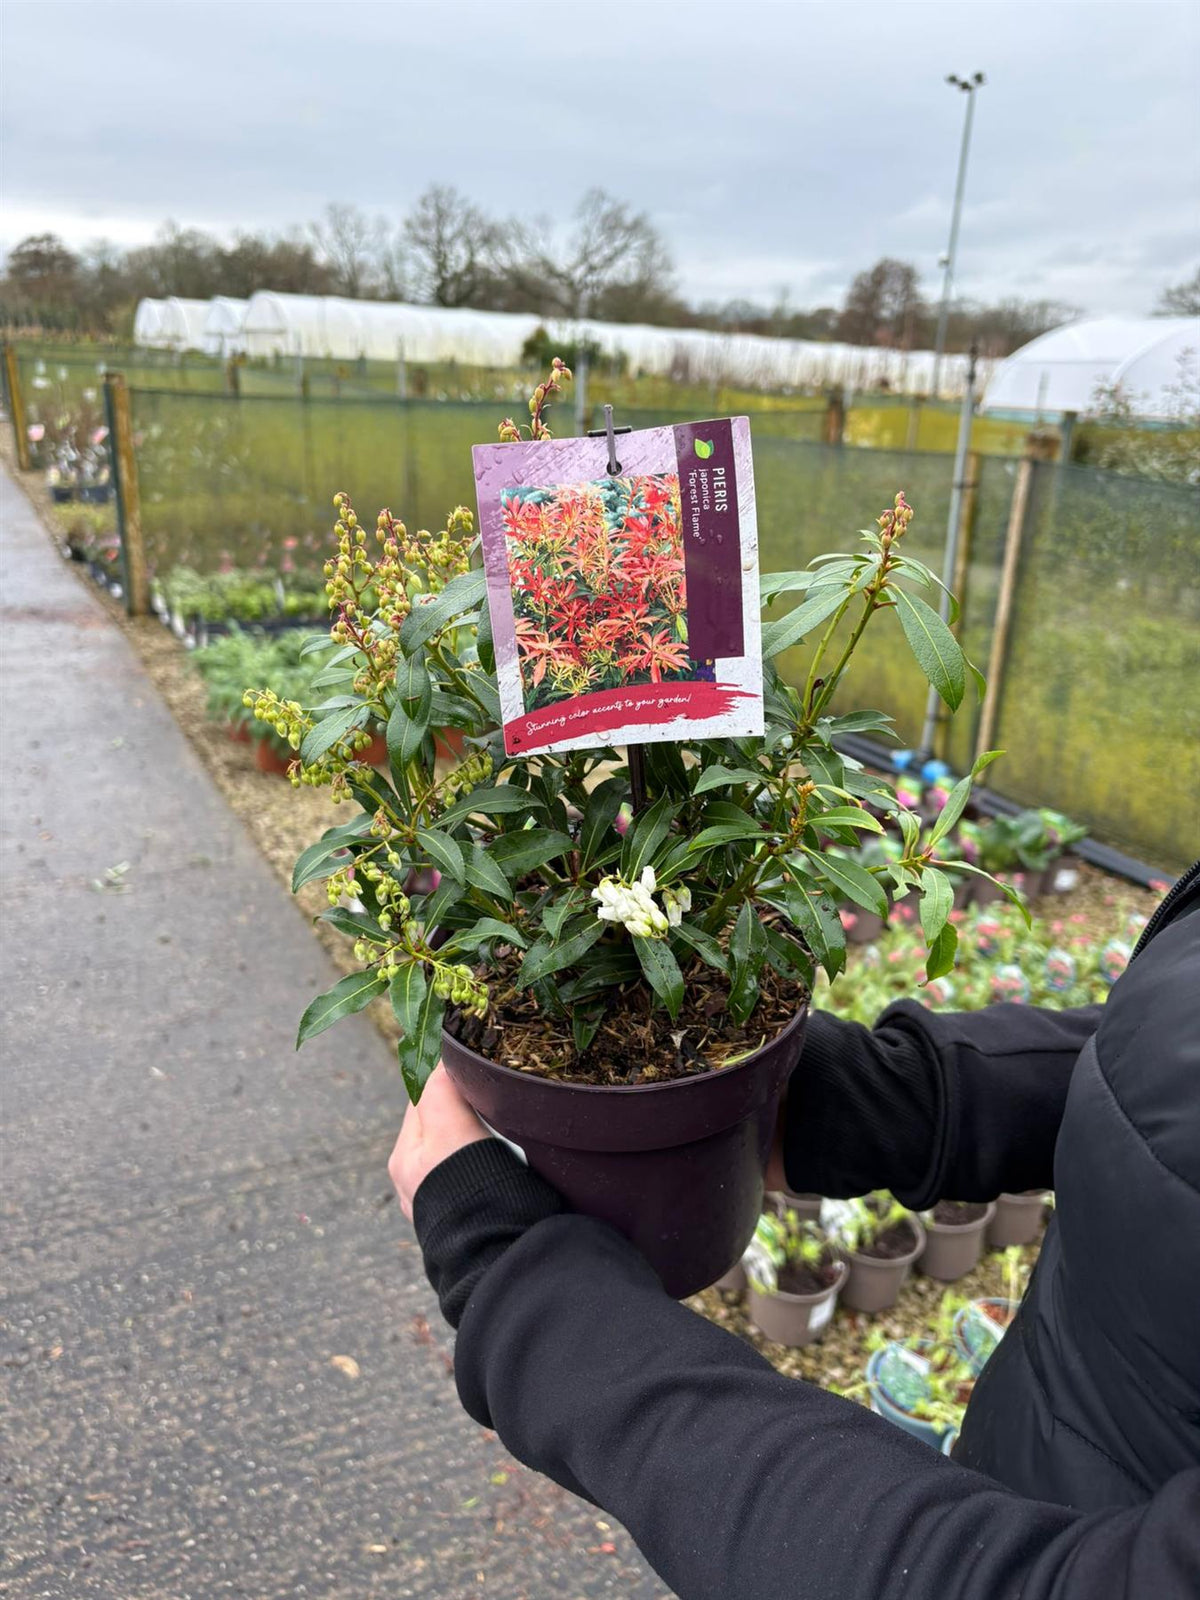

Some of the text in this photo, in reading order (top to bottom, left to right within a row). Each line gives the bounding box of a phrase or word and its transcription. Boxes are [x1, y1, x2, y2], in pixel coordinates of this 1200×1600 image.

[698, 468, 711, 510] japonica
[712, 467, 728, 512] PIERIS
[526, 693, 692, 736] Stunning color accents to your garden!
